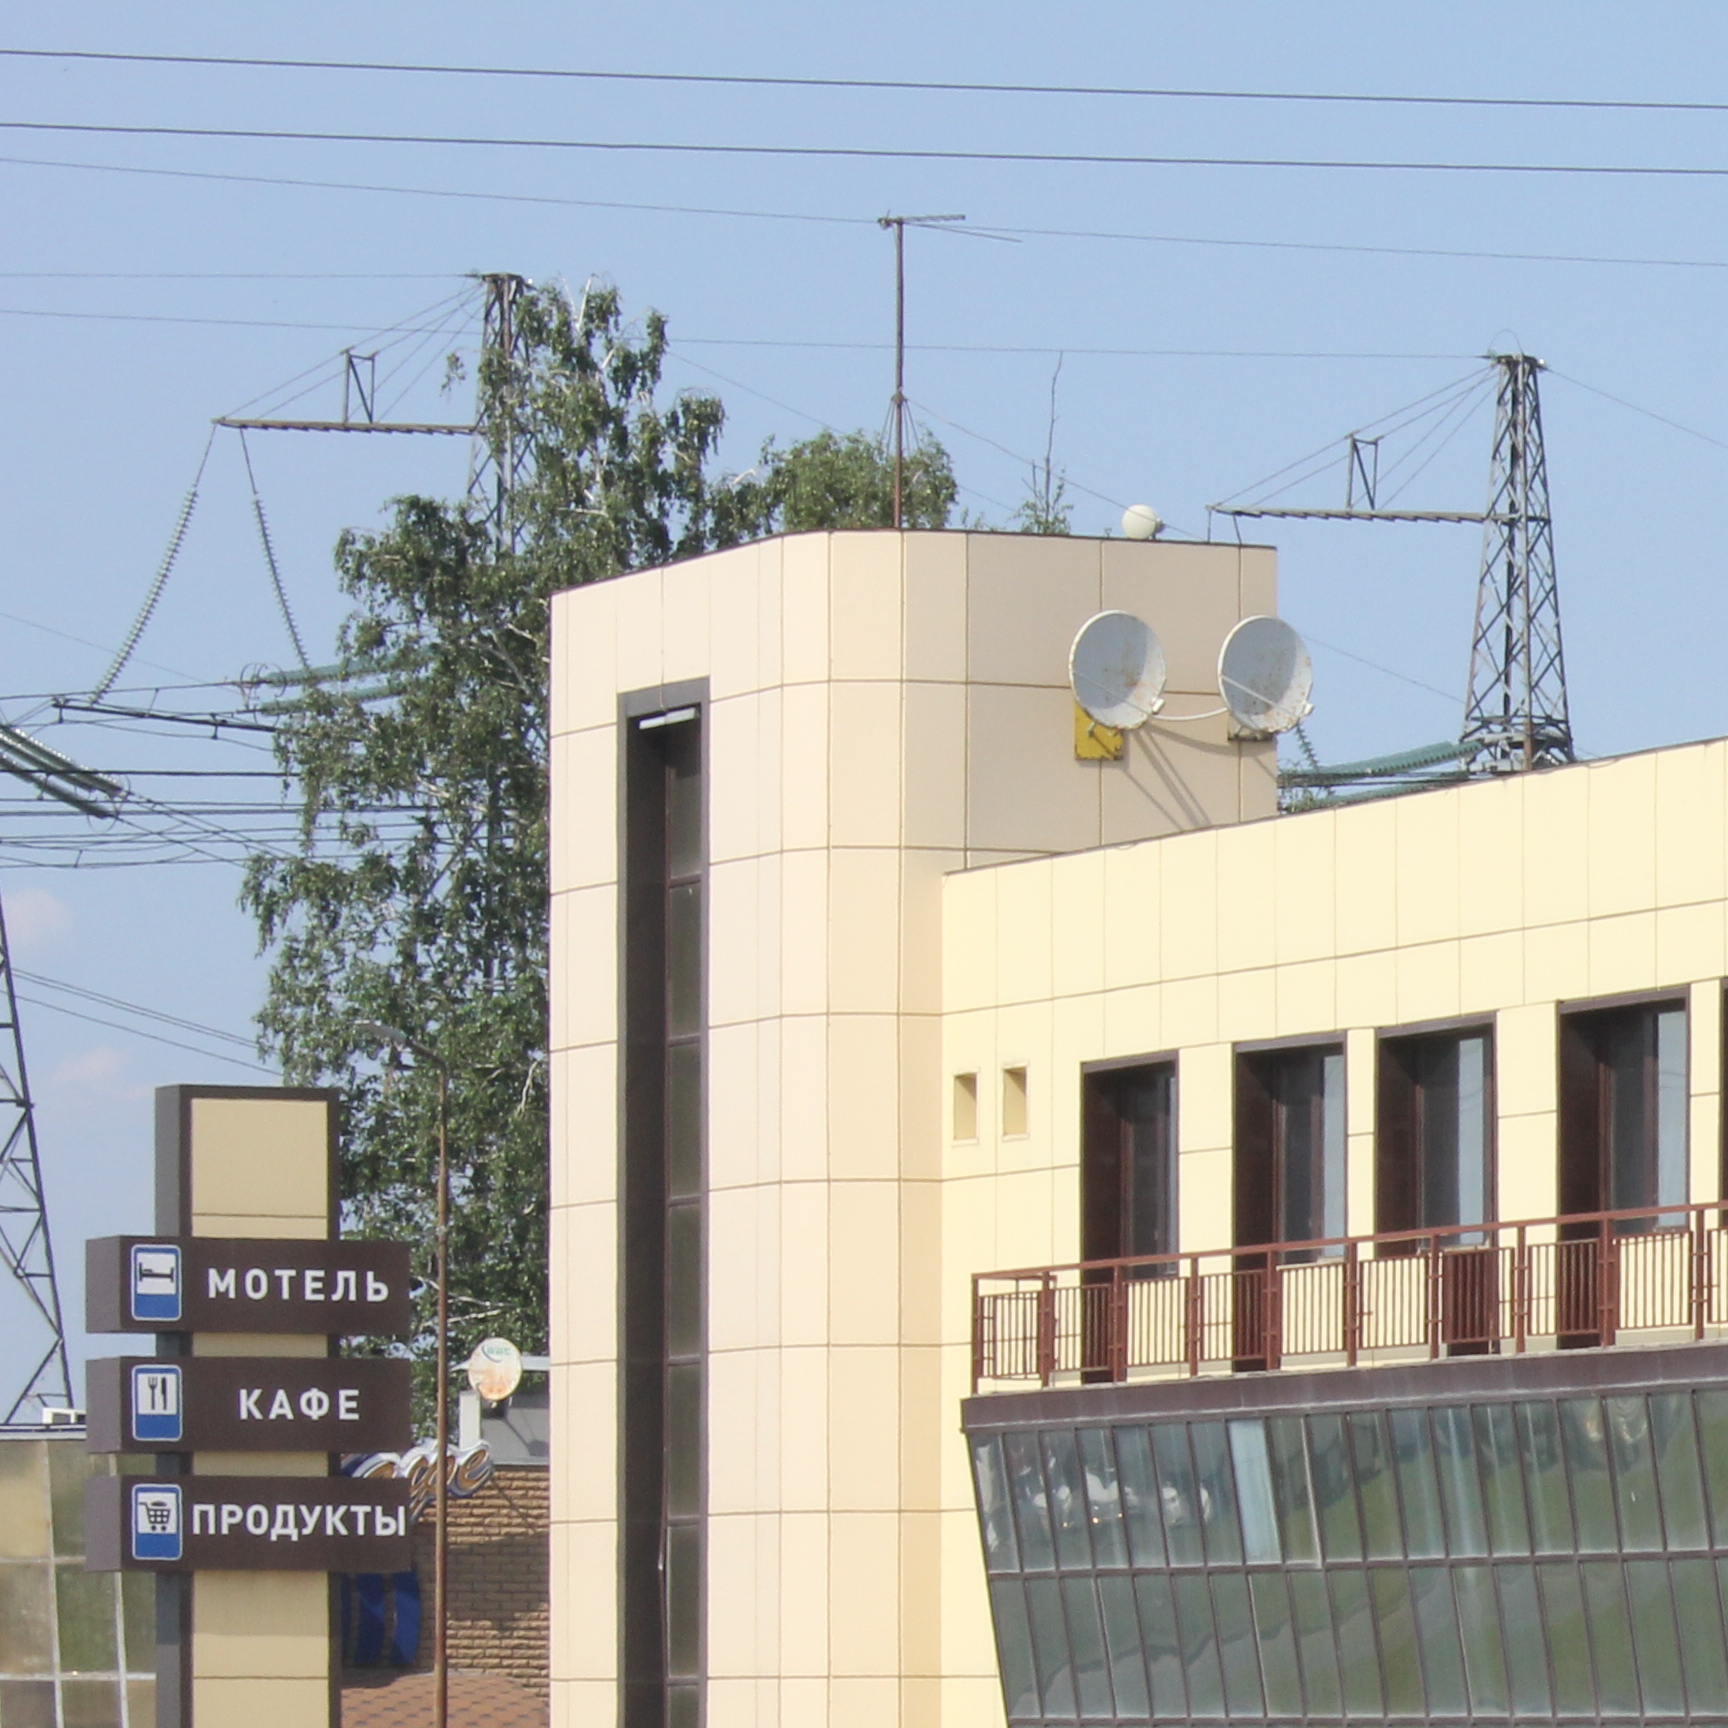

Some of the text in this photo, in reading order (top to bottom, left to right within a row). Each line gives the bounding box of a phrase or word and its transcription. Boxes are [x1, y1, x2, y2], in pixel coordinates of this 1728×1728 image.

[208, 1268, 390, 1302] МОТЕЛЬ
[239, 1388, 361, 1421] КАФЕ
[192, 1503, 407, 1541] ПРОДУКТЫ
